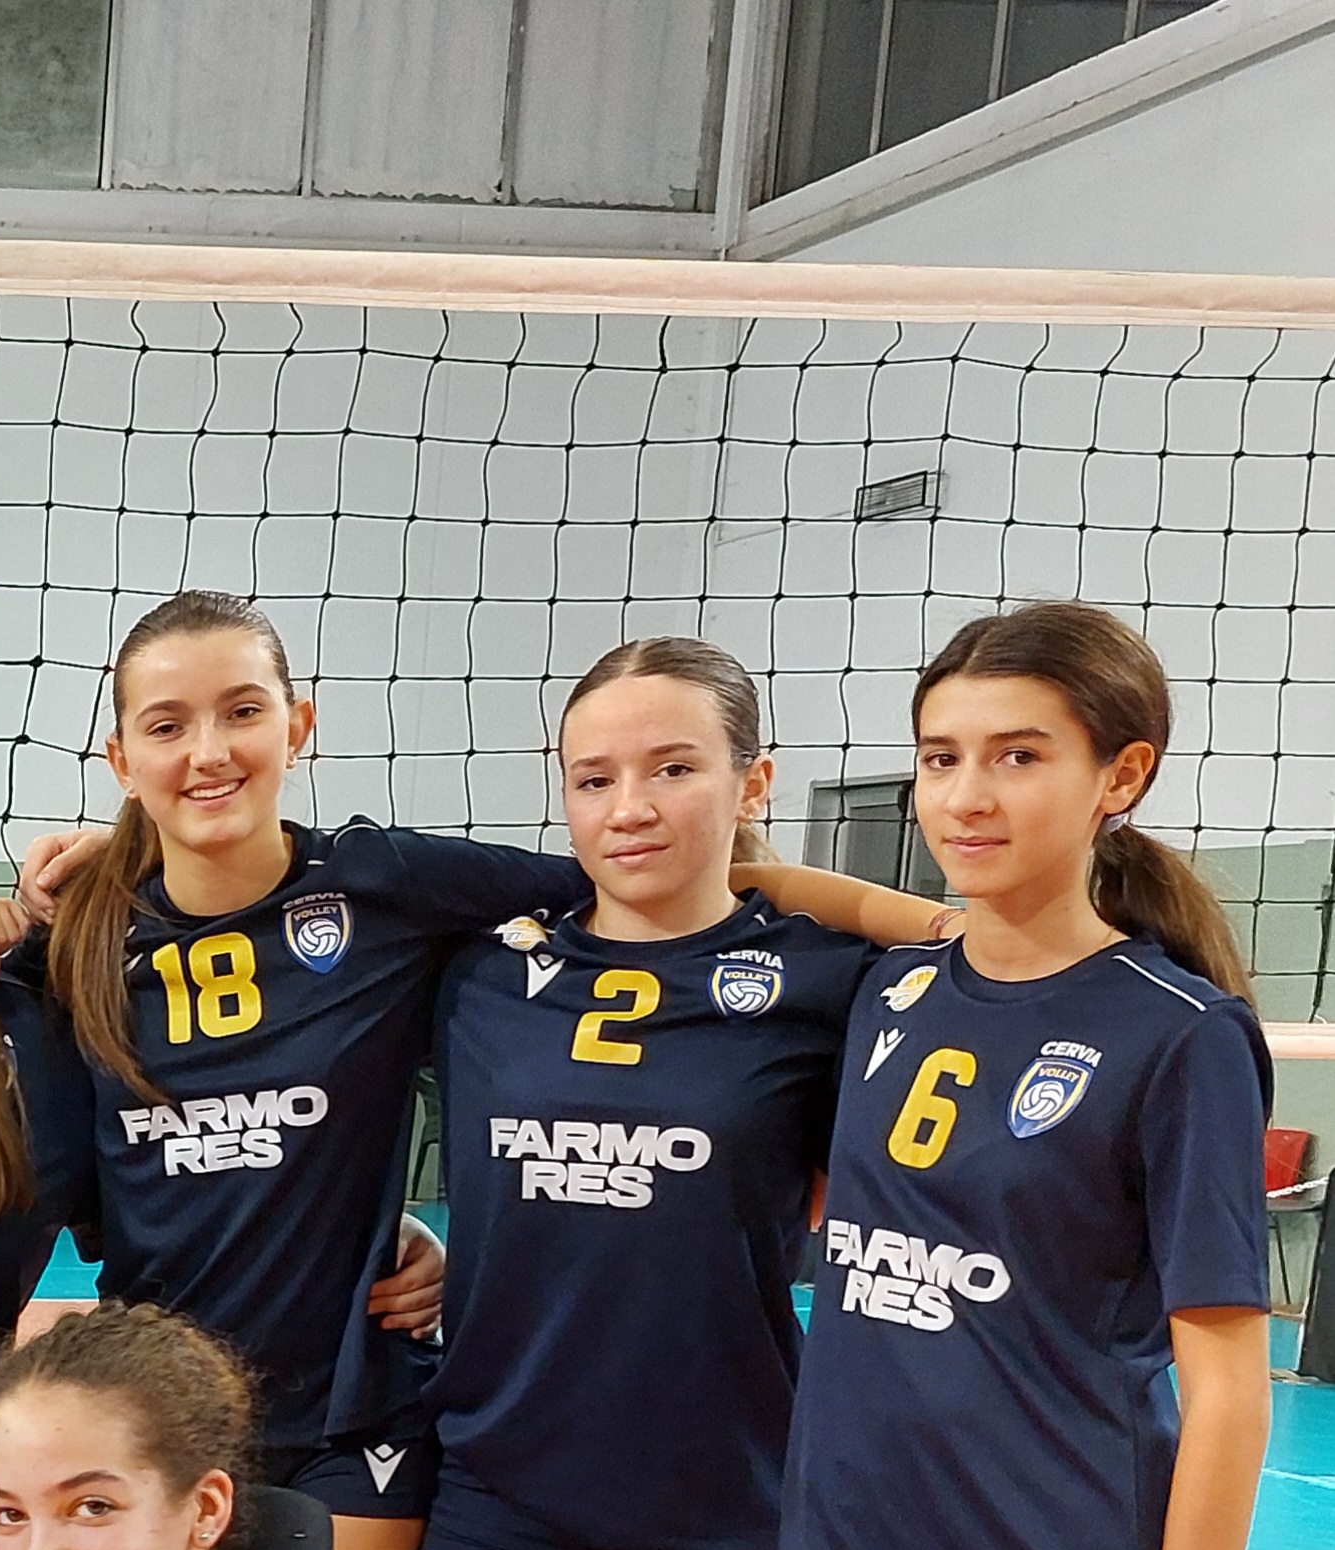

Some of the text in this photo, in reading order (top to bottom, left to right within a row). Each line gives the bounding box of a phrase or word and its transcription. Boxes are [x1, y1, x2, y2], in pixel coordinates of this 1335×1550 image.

[293, 905, 338, 921] VOLLEY
[152, 932, 262, 1043] 18
[571, 969, 661, 1065] 2
[1038, 1067, 1079, 1083] VOLLEY
[1040, 1040, 1103, 1067] CERVIA
[118, 1086, 329, 1144] FARMO
[887, 1047, 977, 1170] 6
[163, 1129, 284, 1176] RES
[490, 1117, 712, 1172] FARMO
[521, 1159, 654, 1208] RES
[826, 1218, 1012, 1303] FARMO
[842, 1267, 954, 1332] RES
